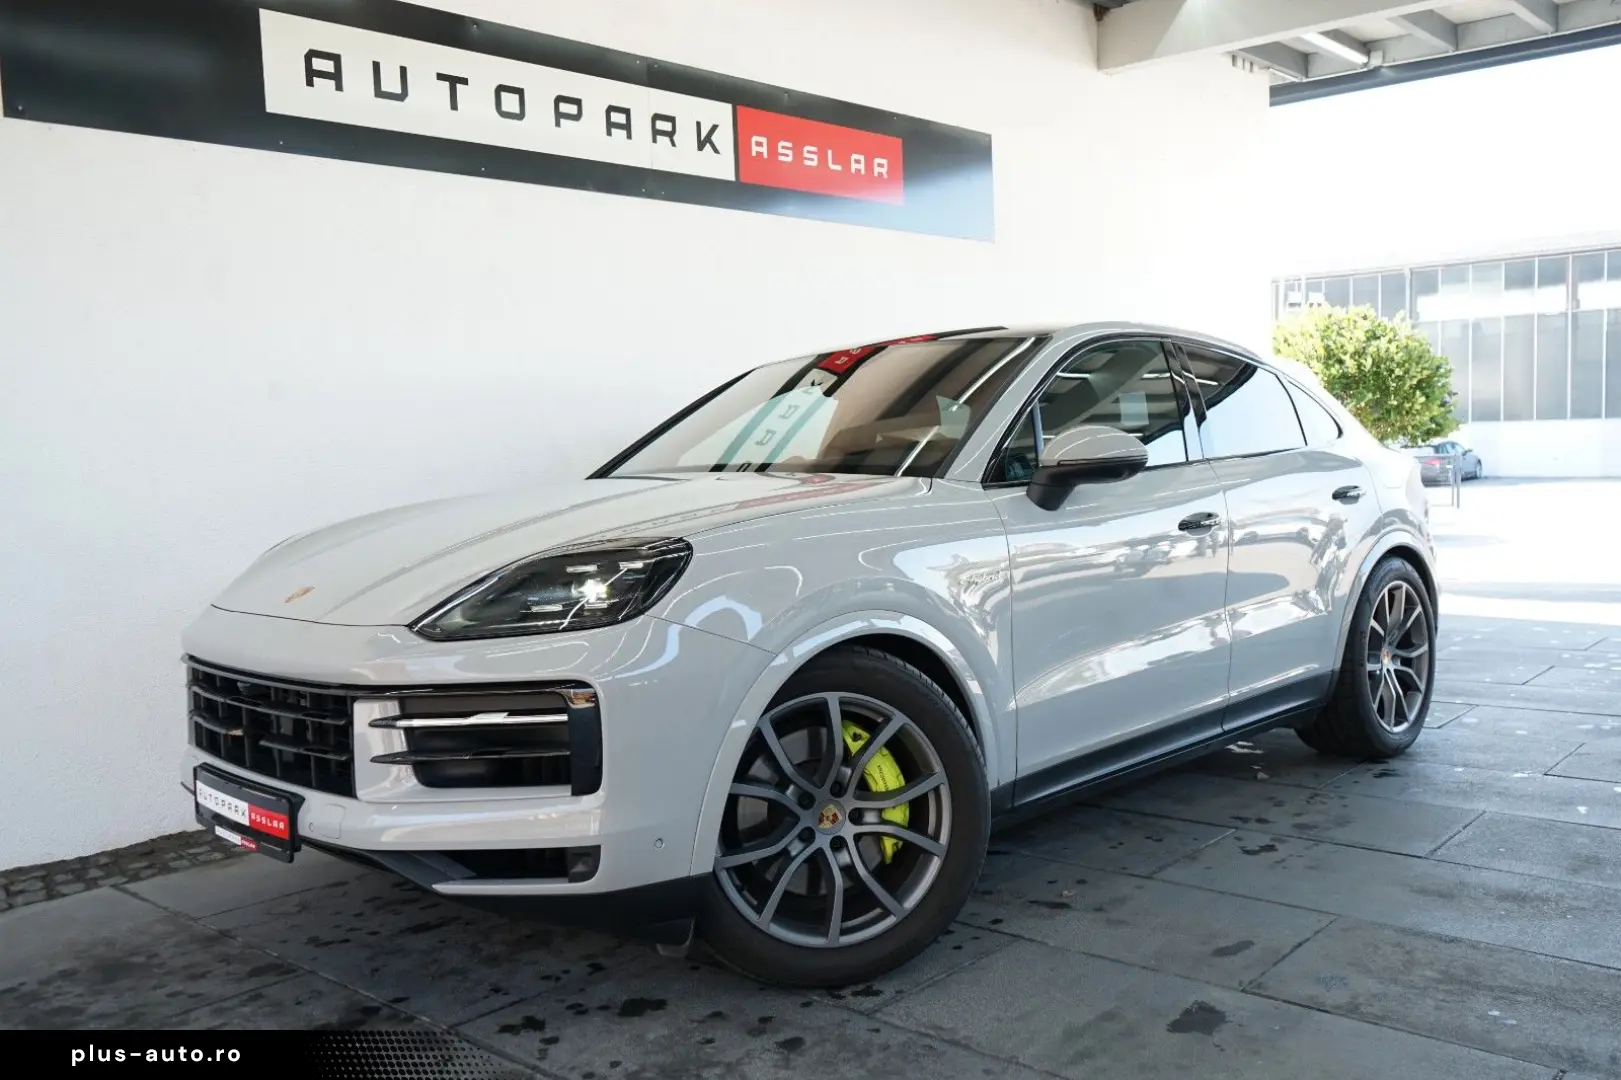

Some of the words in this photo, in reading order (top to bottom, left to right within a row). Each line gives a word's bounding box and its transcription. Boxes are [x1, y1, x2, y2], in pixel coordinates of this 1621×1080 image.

[303, 48, 721, 155] AUTOPARK
[751, 135, 889, 179] ASSLAR
[198, 788, 247, 818] AUTOPARK
[250, 812, 285, 830] ASSLAR
